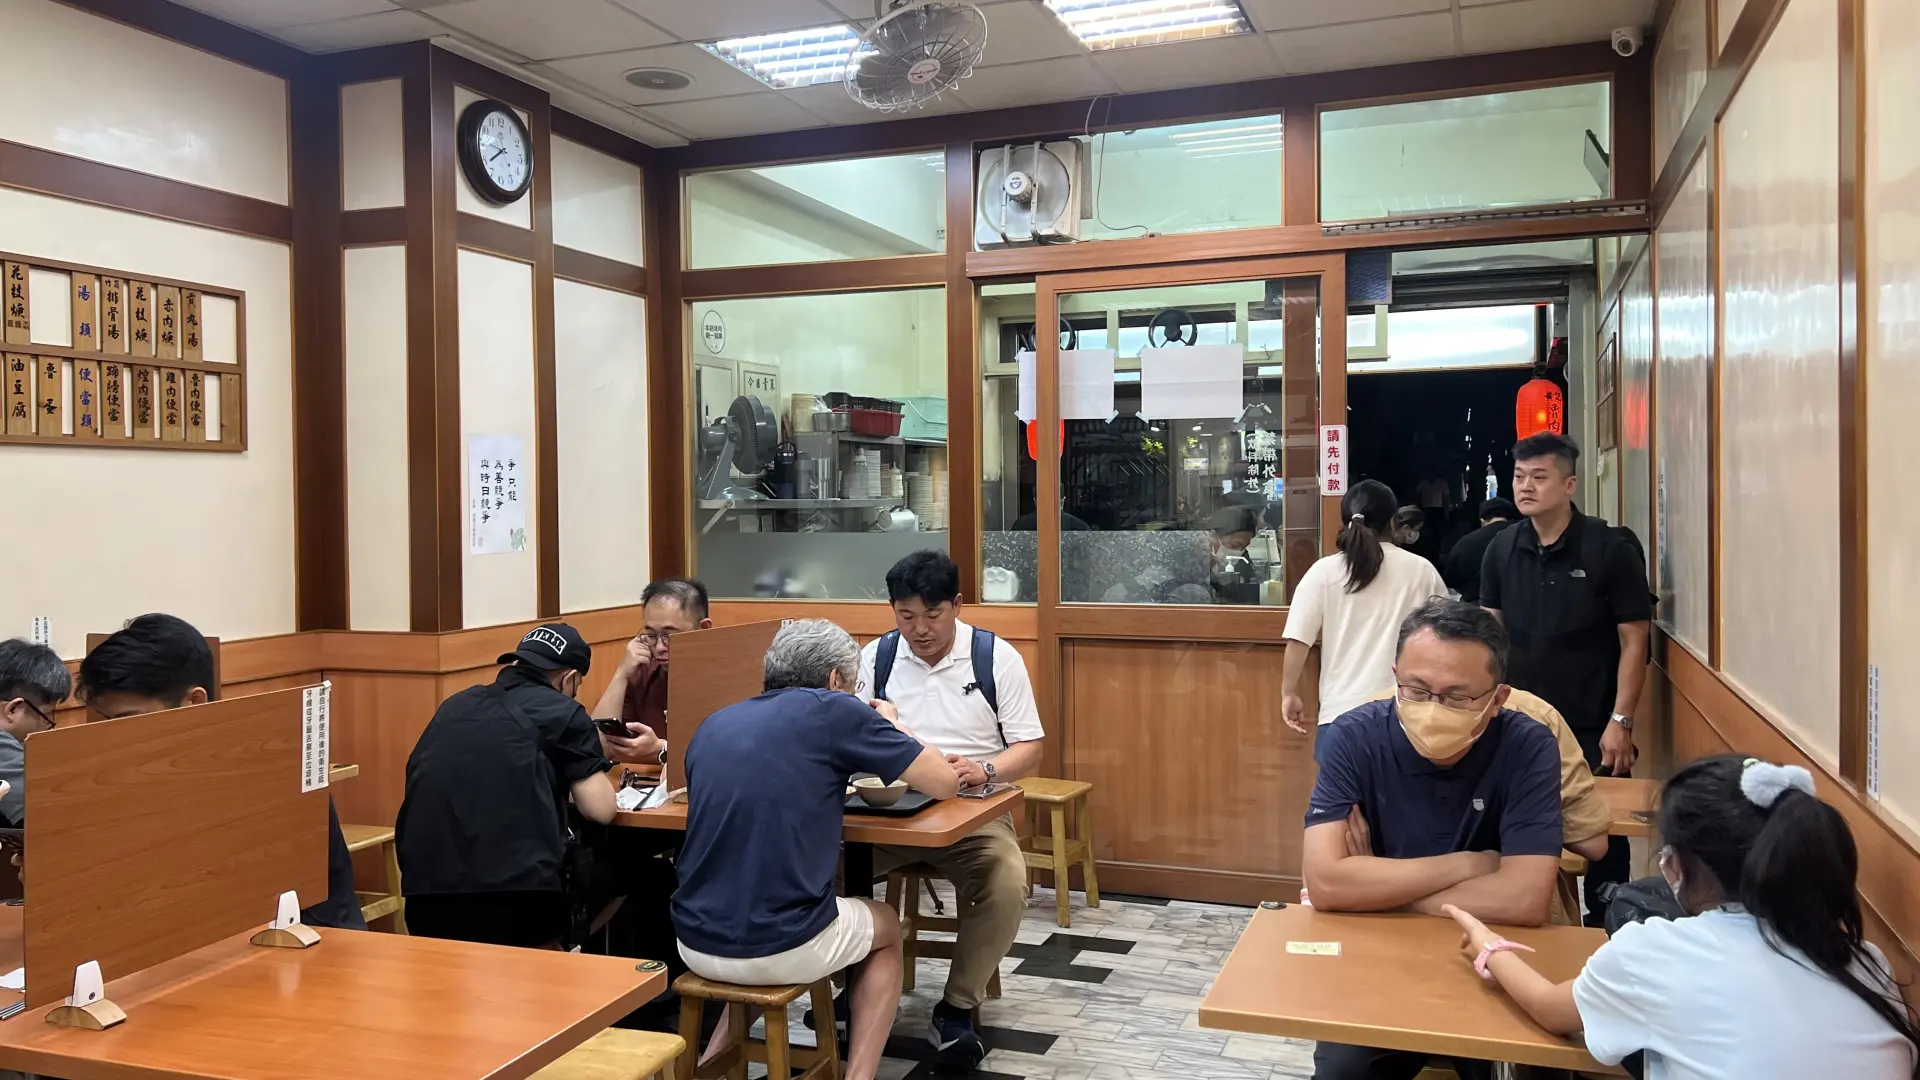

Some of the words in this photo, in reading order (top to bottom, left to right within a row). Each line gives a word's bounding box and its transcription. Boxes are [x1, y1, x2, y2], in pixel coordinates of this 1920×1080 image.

[498, 117, 505, 128] 12
[78, 284, 91, 338] 湯類
[107, 290, 120, 340] 排骨湯
[186, 292, 199, 348] 貢丸湯
[11, 358, 26, 419] 油豆腐
[44, 362, 58, 415] 魯蛋
[79, 367, 93, 429] 便當類
[190, 373, 203, 427] 魯肉便當
[1327, 429, 1340, 491] 請先付款
